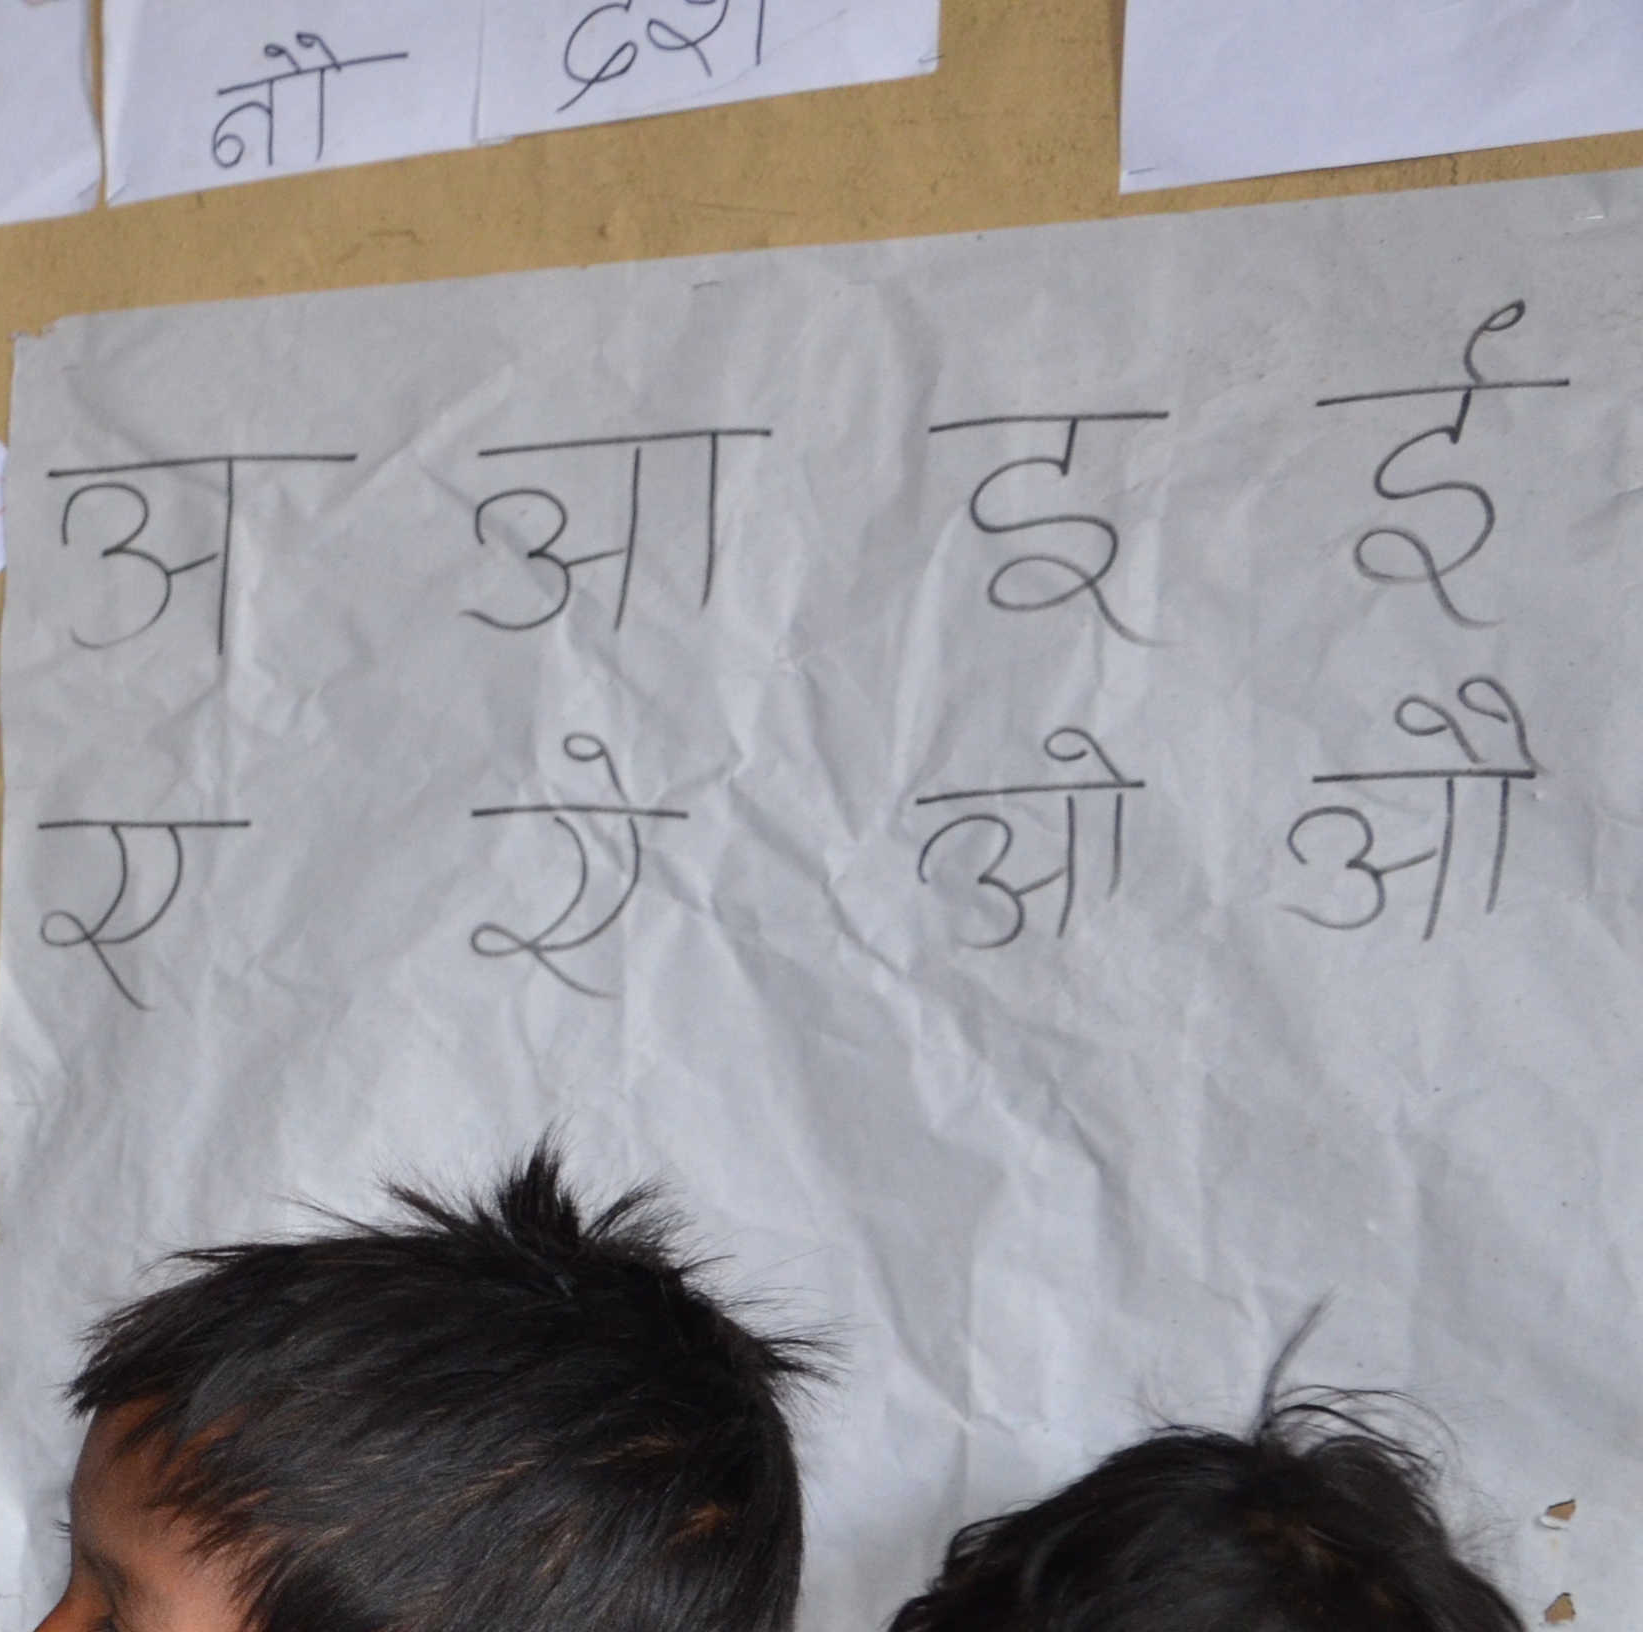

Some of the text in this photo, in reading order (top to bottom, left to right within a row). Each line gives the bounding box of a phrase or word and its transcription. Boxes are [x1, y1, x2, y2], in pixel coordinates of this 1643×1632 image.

[210, 30, 408, 169] नौ
[48, 299, 1572, 656] अ आ इ ई
[37, 675, 1540, 1012] ए ऐ ओ औ
